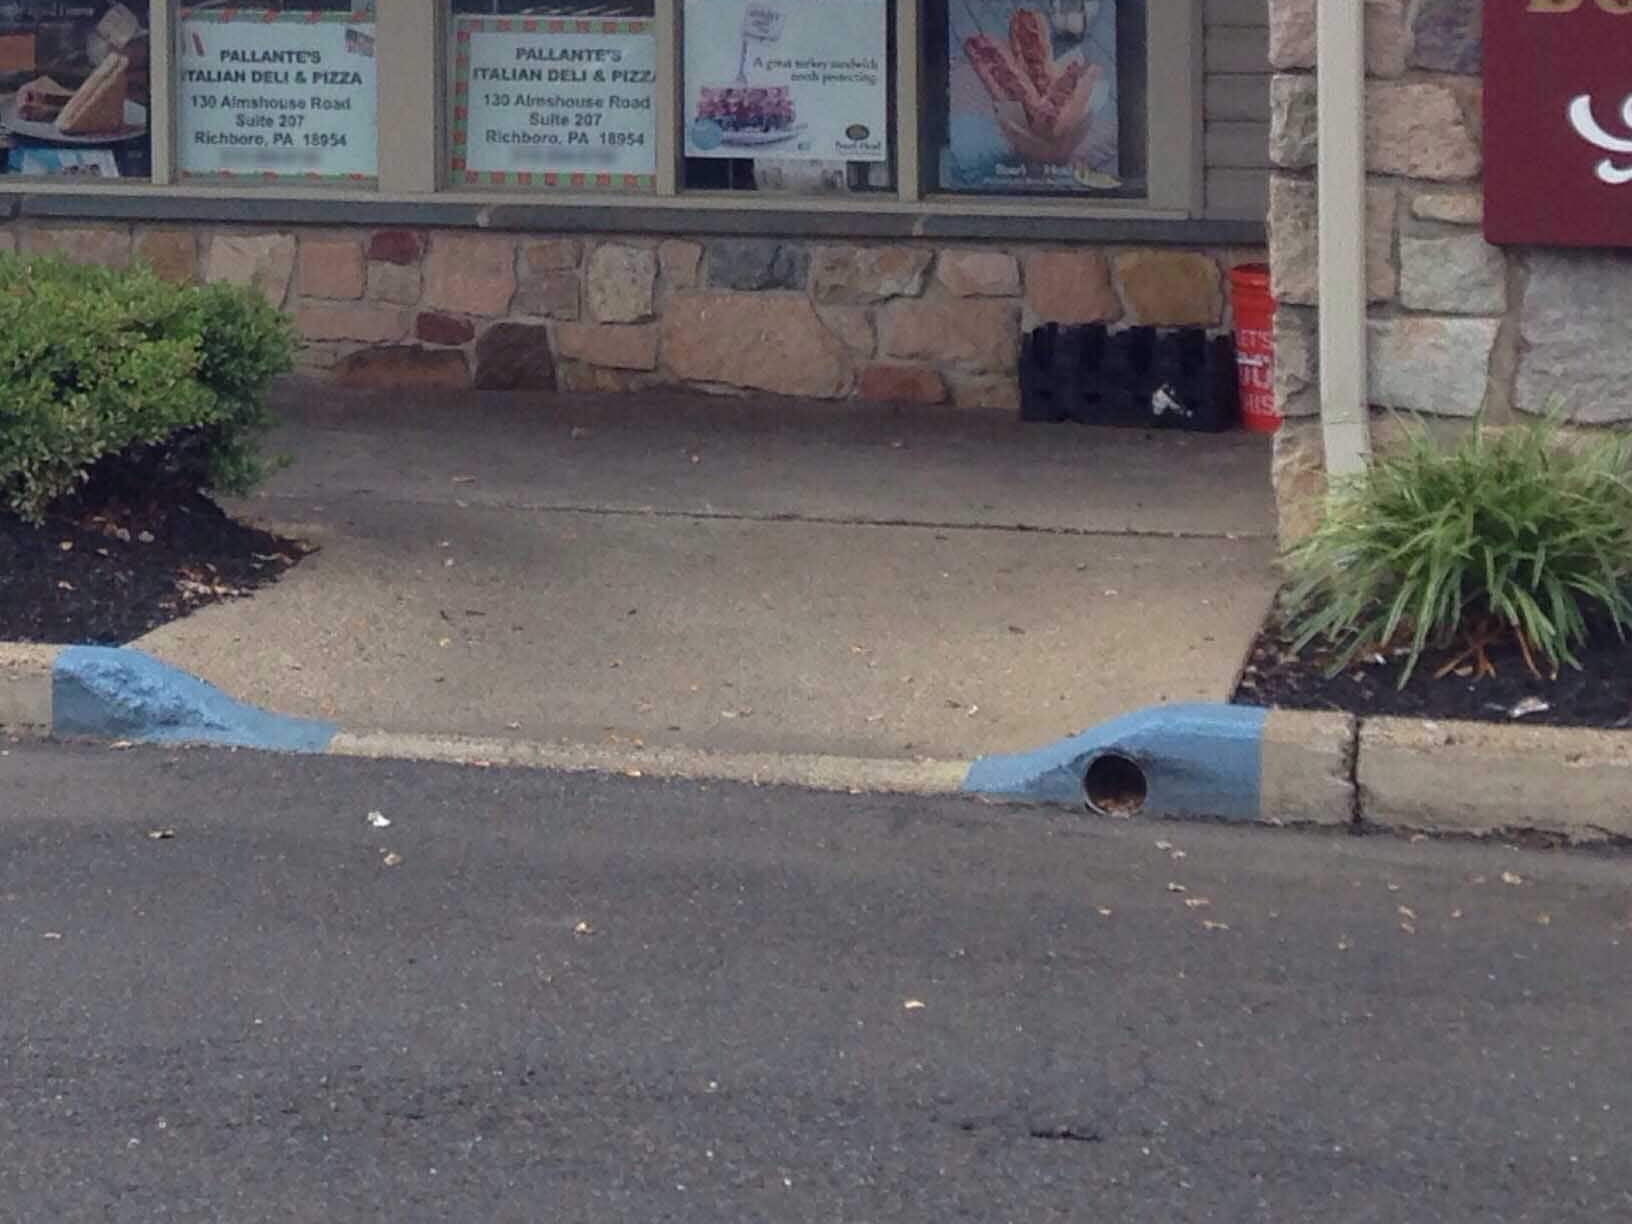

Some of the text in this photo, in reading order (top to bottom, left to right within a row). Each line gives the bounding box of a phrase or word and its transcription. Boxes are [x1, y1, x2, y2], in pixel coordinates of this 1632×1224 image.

[219, 49, 322, 65] PALLANTE'S
[515, 47, 623, 63] PALLANTE'S
[251, 70, 289, 85] DELI
[293, 70, 307, 85] &
[311, 71, 363, 86] PIZZA
[472, 67, 542, 83] ITALIAN
[547, 68, 587, 83] DELI
[592, 69, 606, 83] &
[191, 95, 351, 111] 130 Almshouse Road
[483, 93, 651, 110] 130 Almshouse Road
[235, 114, 305, 127] Suite 207
[528, 112, 603, 127] Suite 207
[272, 132, 294, 146] PA
[303, 132, 348, 147] 18954
[567, 131, 590, 145] PA
[598, 132, 645, 146] 18954
